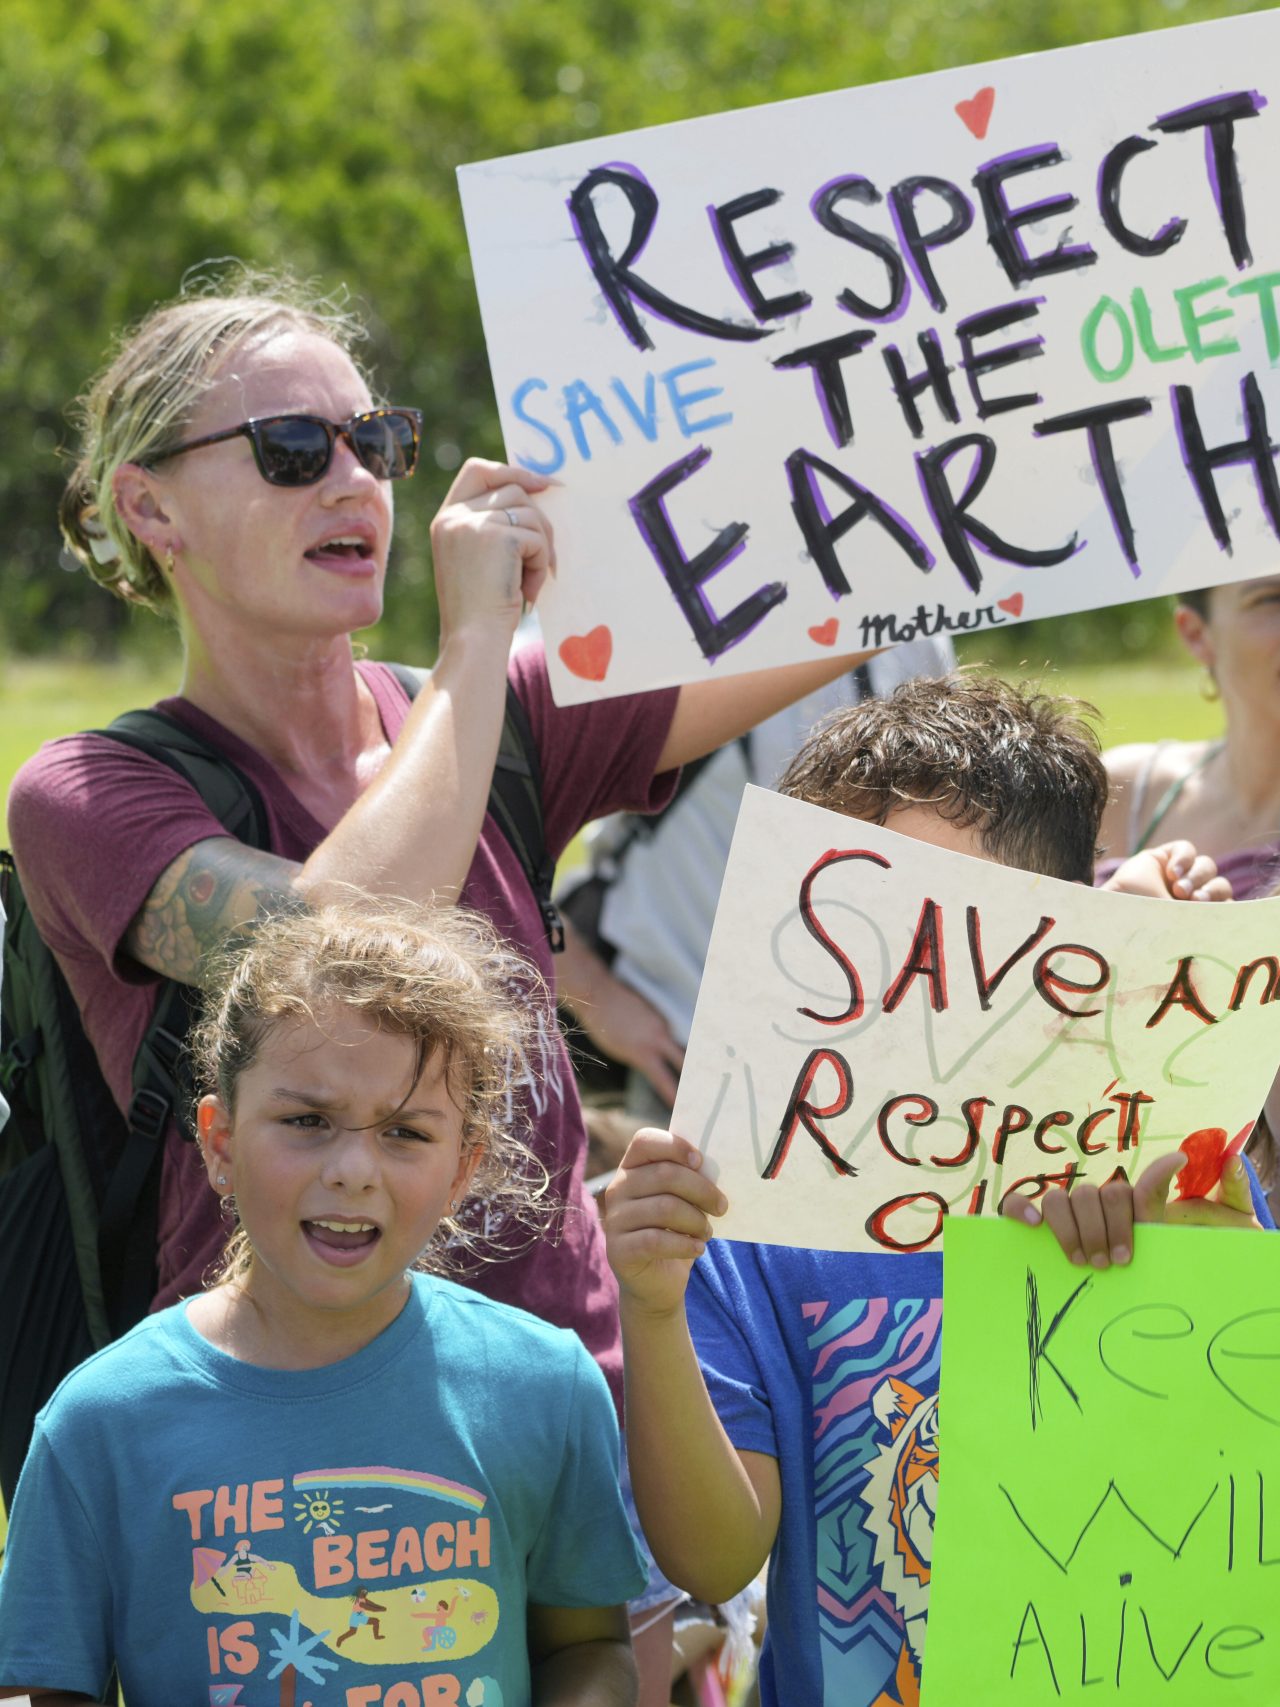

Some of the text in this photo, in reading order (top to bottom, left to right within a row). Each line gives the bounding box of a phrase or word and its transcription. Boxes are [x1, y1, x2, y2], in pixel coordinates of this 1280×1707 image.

[567, 89, 1268, 351] RESPECT
[774, 296, 1047, 448] THE
[510, 358, 734, 476] SAVE
[858, 604, 1006, 647] Mother
[172, 1478, 285, 1541] THE
[312, 1517, 491, 1589] BEACH
[207, 1620, 259, 1675] IS
